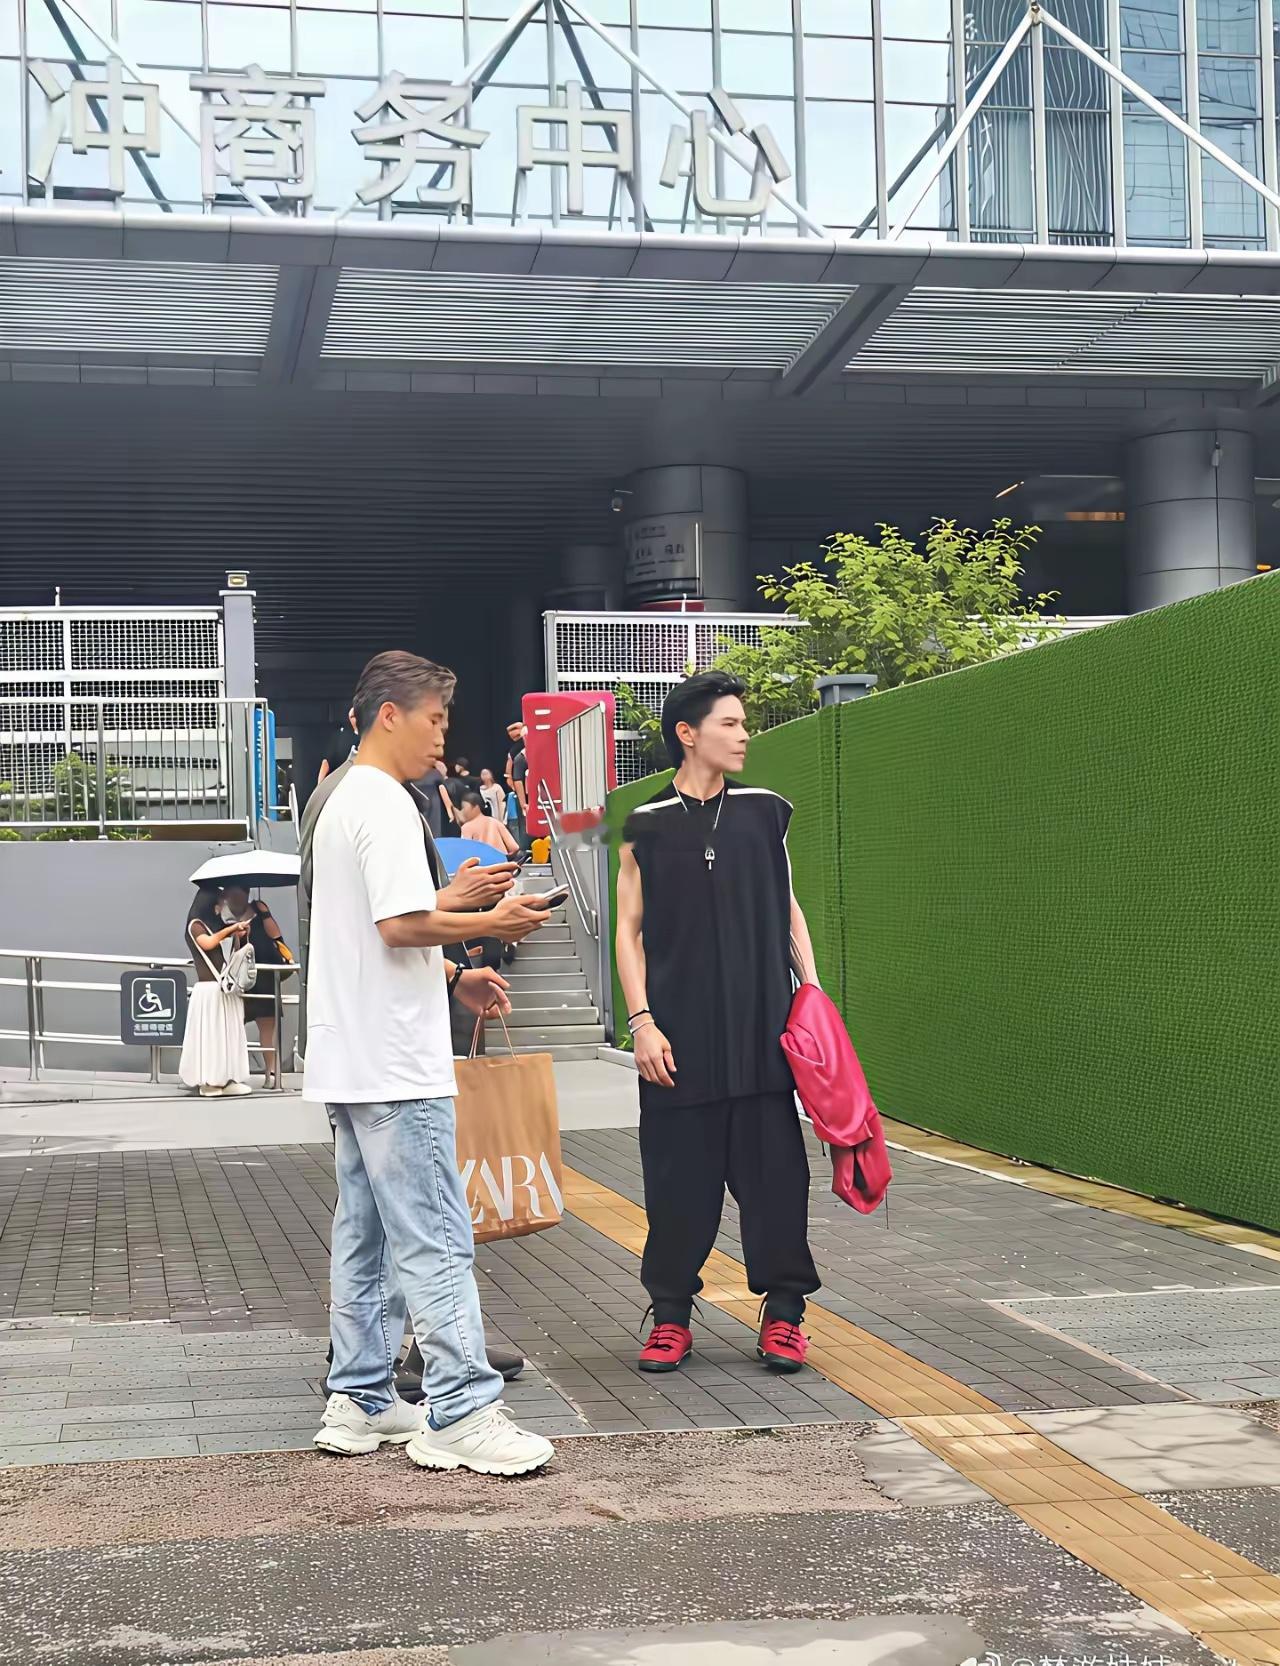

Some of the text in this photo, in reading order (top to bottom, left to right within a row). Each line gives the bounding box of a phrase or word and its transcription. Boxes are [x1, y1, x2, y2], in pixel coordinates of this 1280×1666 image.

[27, 56, 791, 216] 冲商务中心
